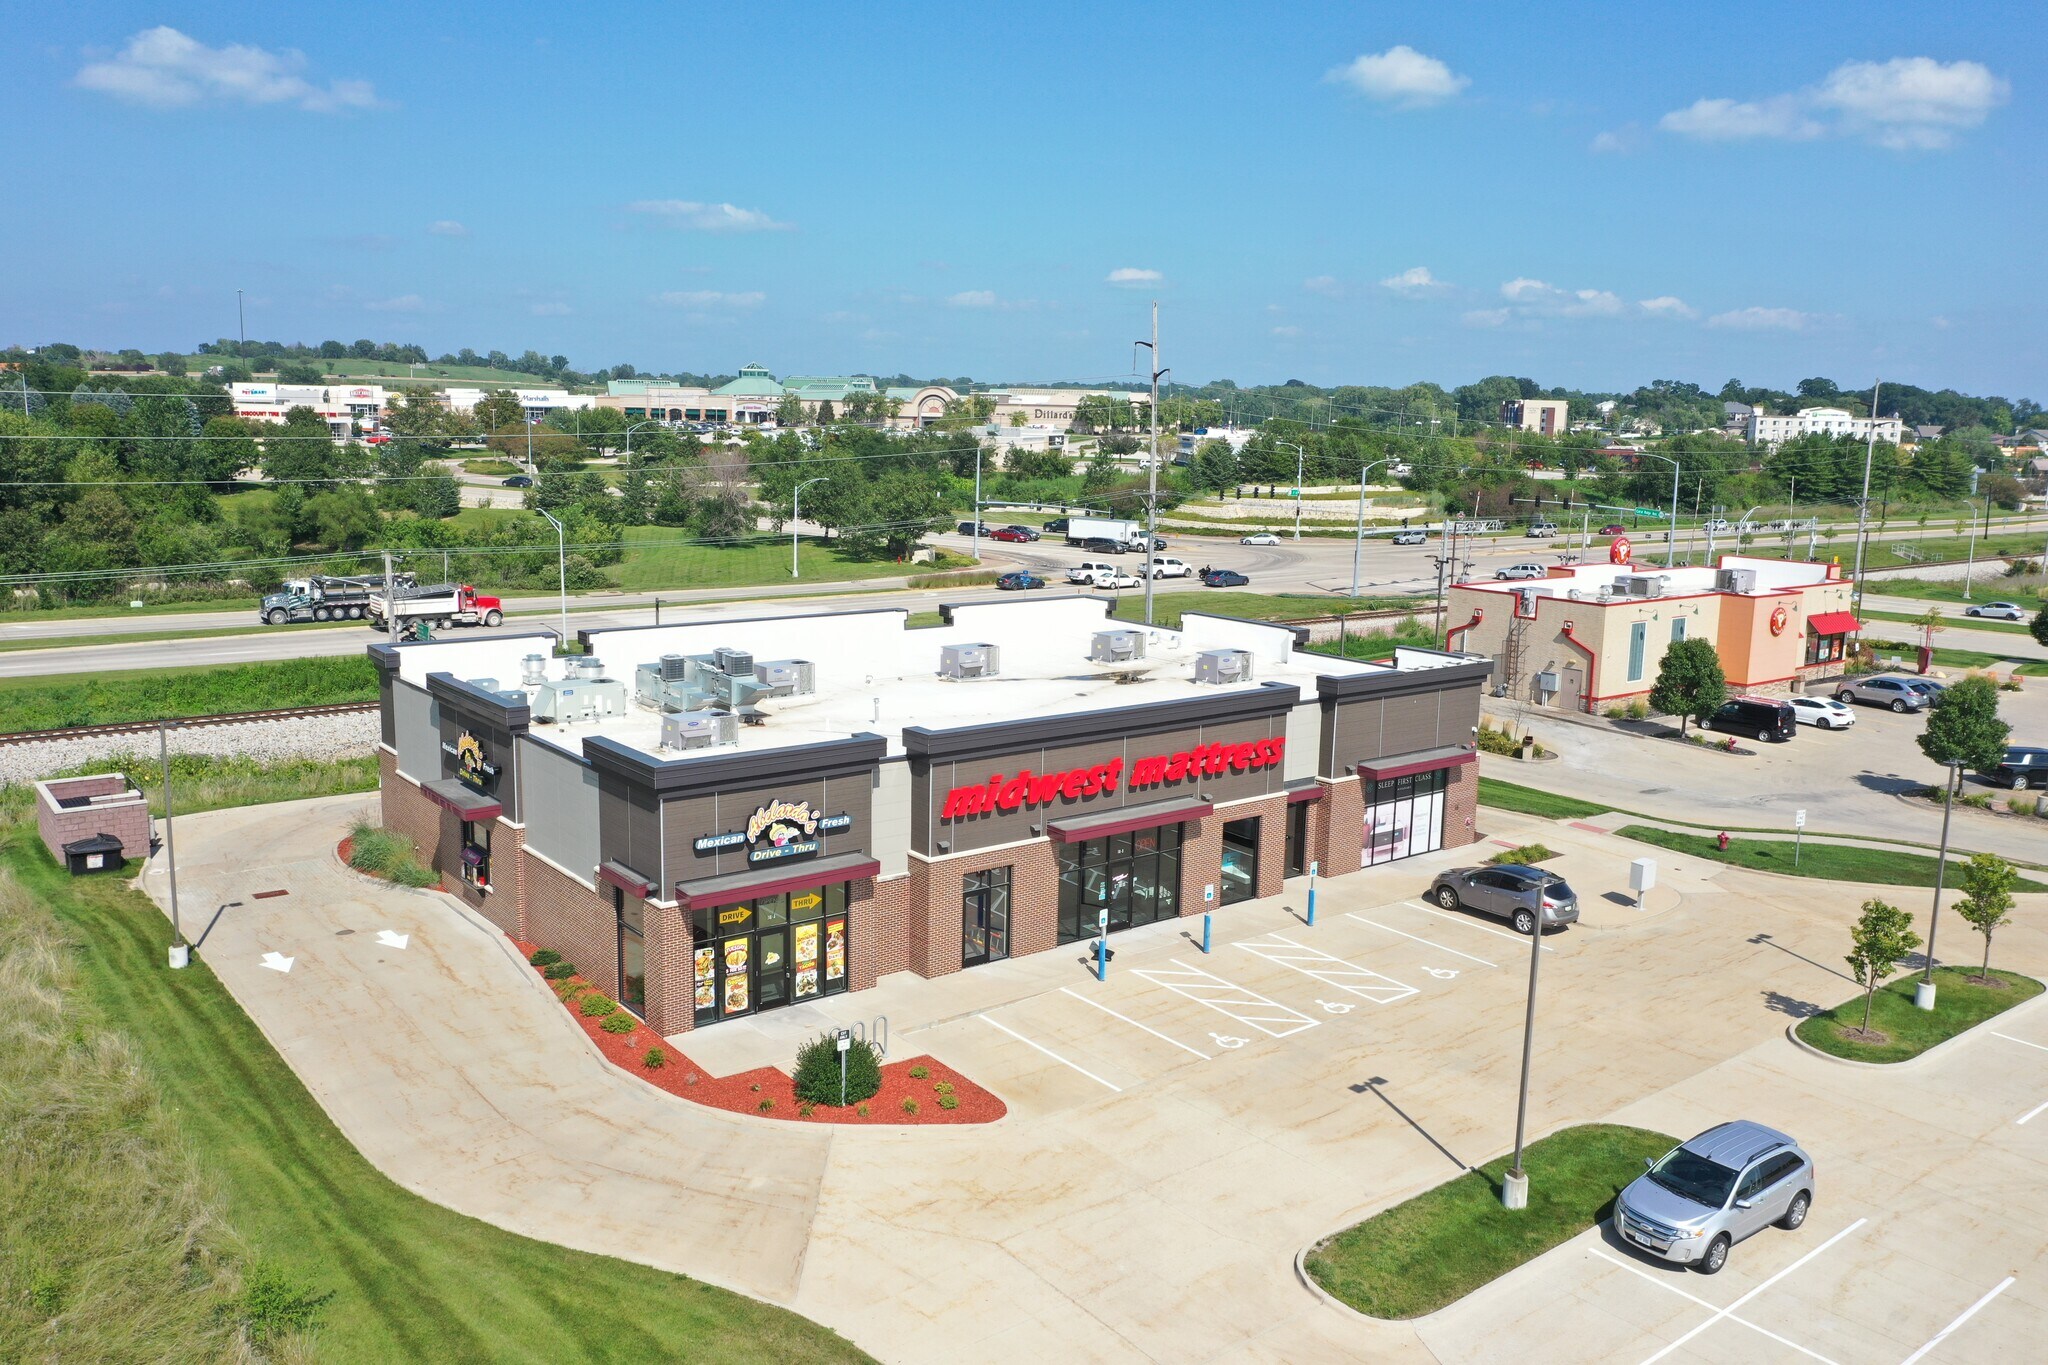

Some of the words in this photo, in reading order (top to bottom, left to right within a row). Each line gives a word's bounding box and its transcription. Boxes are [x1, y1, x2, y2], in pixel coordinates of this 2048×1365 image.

[1034, 408, 1073, 419] Dillard's
[941, 757, 1123, 818] midwest
[1129, 736, 1286, 787] mattress
[1377, 780, 1395, 790] SLEEP
[1397, 776, 1413, 786] FIRST
[1414, 772, 1432, 783] CLASS
[747, 799, 821, 843] Abelardo's
[822, 815, 850, 828] Fresh
[697, 834, 744, 849] Mexican
[1136, 837, 1156, 850] OPEN
[753, 848, 782, 861] Drive
[792, 842, 816, 853] Thru
[793, 898, 813, 908] THRU
[722, 910, 744, 921] DRIVE
